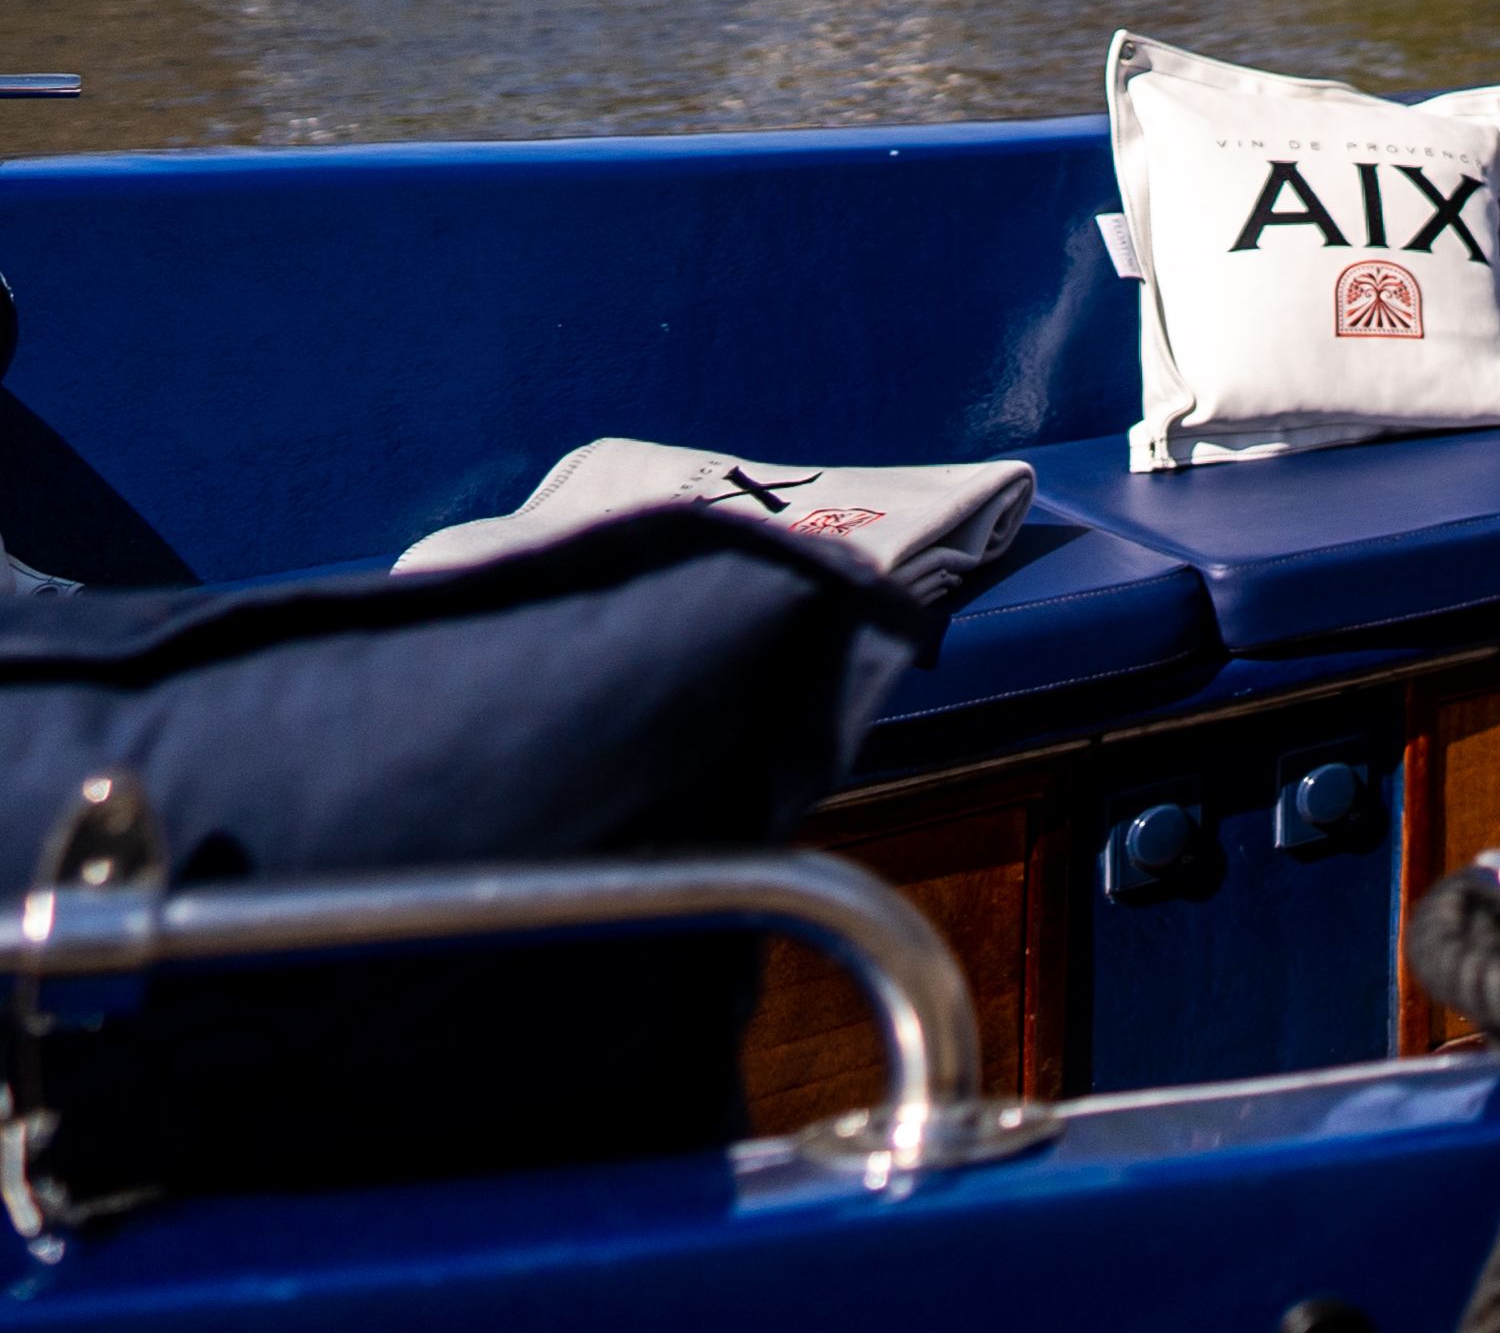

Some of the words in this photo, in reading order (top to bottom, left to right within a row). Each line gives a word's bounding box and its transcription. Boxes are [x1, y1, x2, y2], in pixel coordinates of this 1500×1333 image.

[1216, 140, 1264, 148] VIN
[1289, 140, 1321, 150] DE
[1227, 160, 1491, 265] AIX
